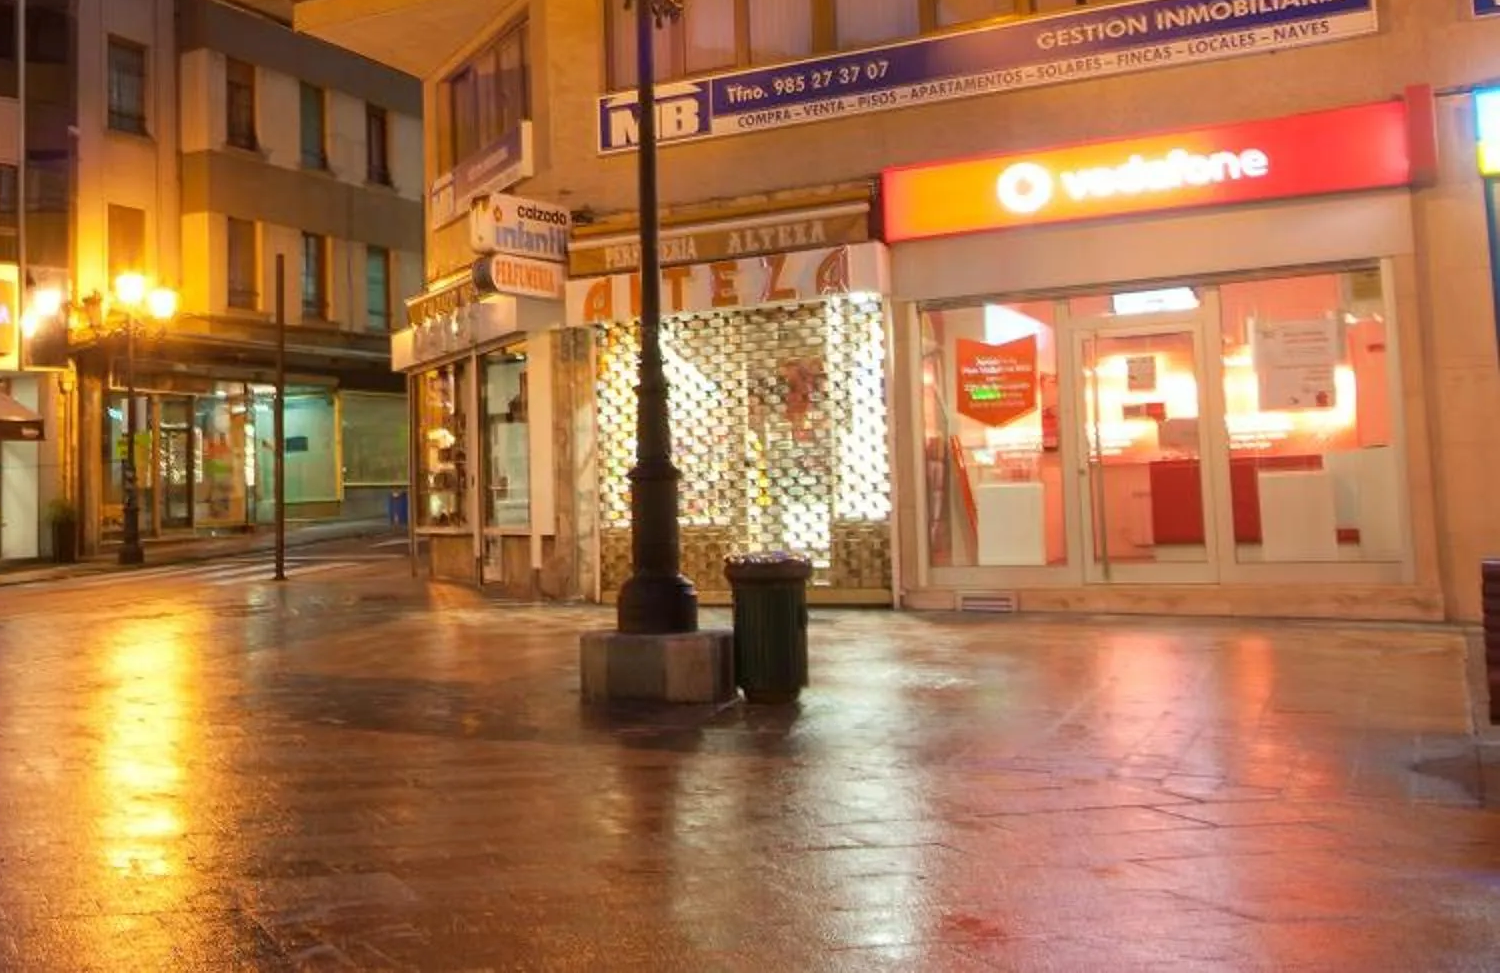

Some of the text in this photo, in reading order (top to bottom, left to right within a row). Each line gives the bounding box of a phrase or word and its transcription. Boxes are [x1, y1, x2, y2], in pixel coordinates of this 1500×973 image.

[1036, 10, 1148, 50] GESTION
[725, 60, 890, 104] Tfno. 985 27 37 07
[737, 20, 1330, 129] COMPRA VENTA PISOS APARTAMENTOS SOLARES FINCAS LOCALES NAVES
[1058, 147, 1269, 200] vodafone
[517, 202, 567, 226] calzado
[495, 221, 567, 255] infantil
